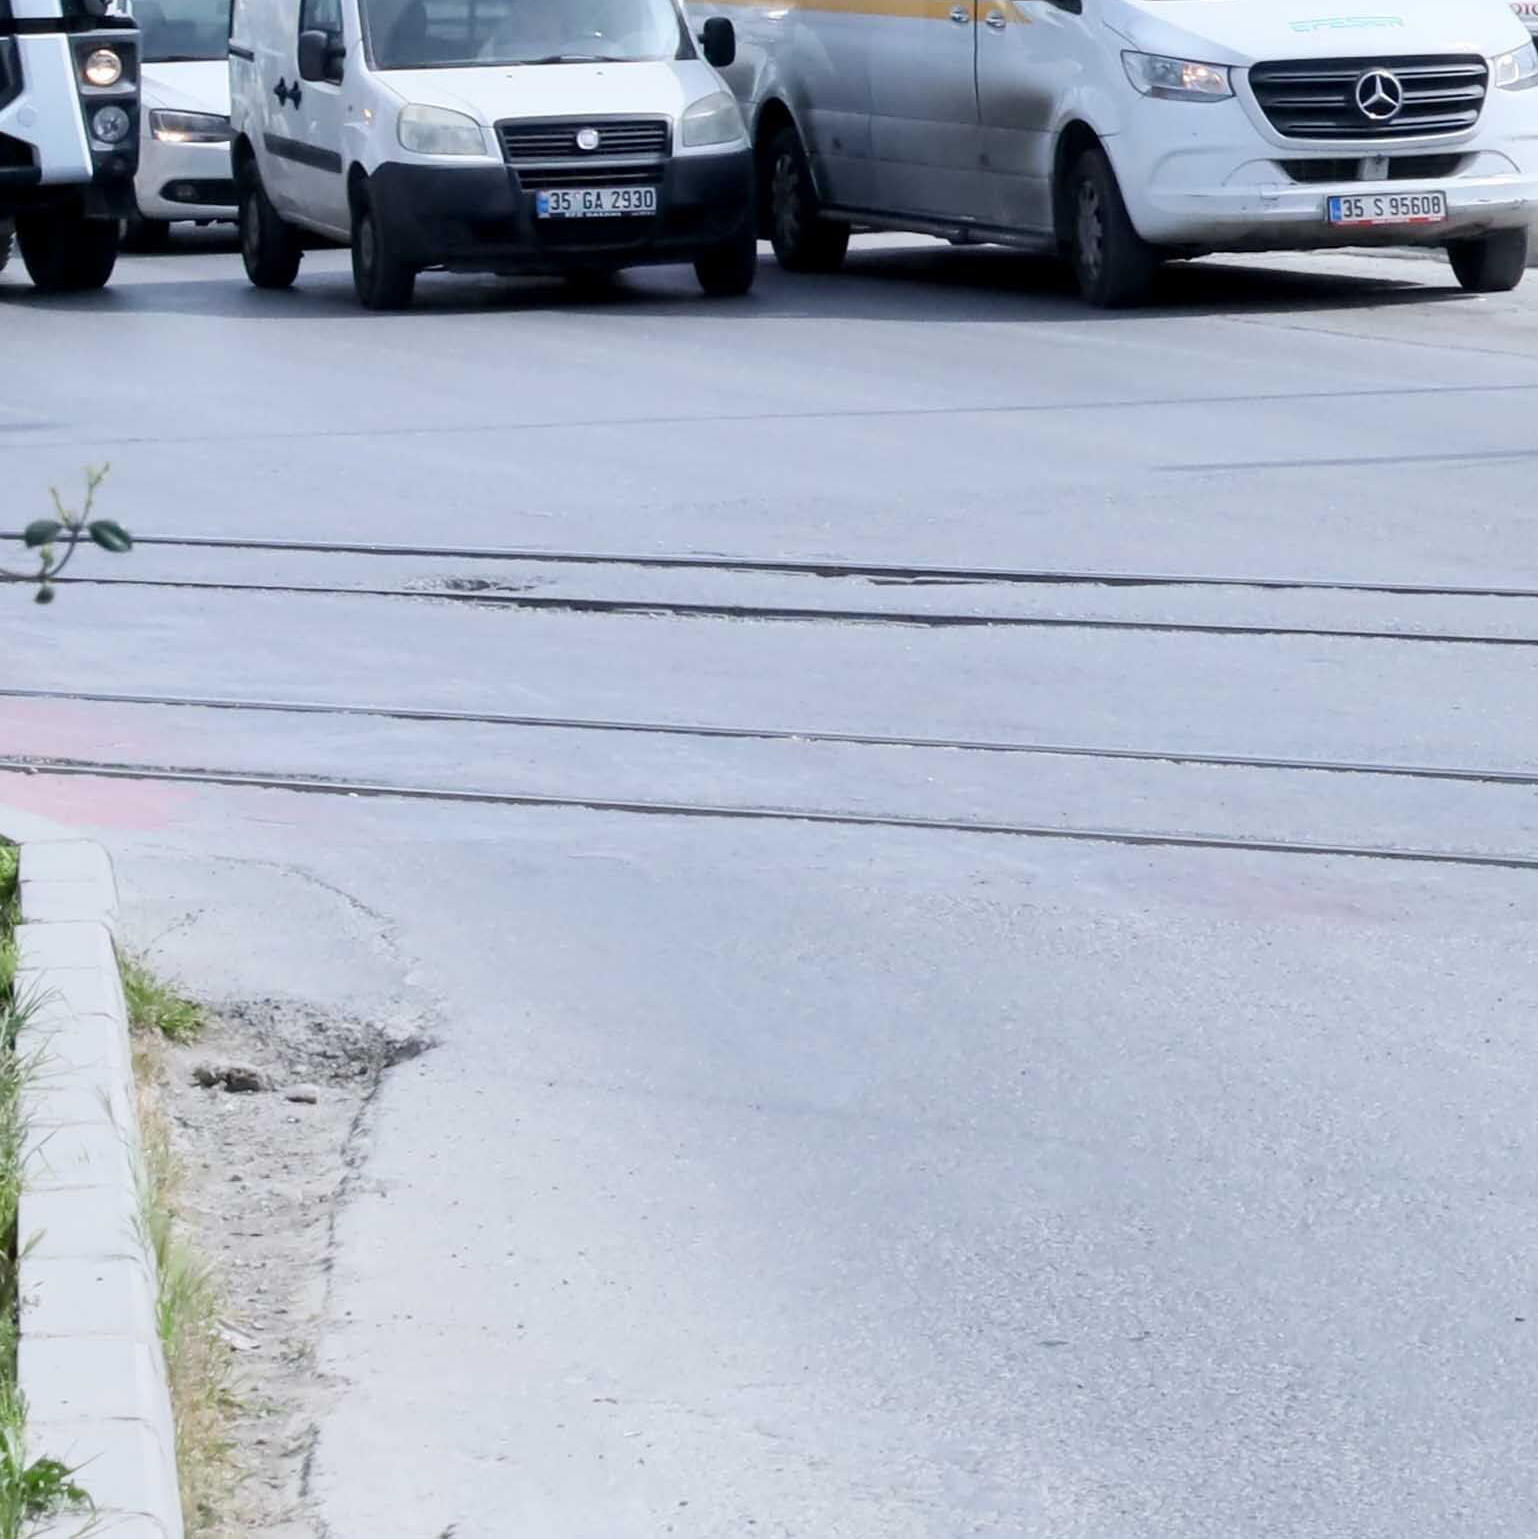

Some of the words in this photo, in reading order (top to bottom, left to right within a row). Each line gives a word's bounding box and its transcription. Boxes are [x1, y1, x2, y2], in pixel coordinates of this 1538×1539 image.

[550, 191, 571, 211] 35
[582, 191, 604, 210] GA
[611, 190, 654, 209] 2930
[1343, 198, 1364, 218] 35
[1374, 198, 1384, 217] S
[1389, 196, 1441, 216] 95608
